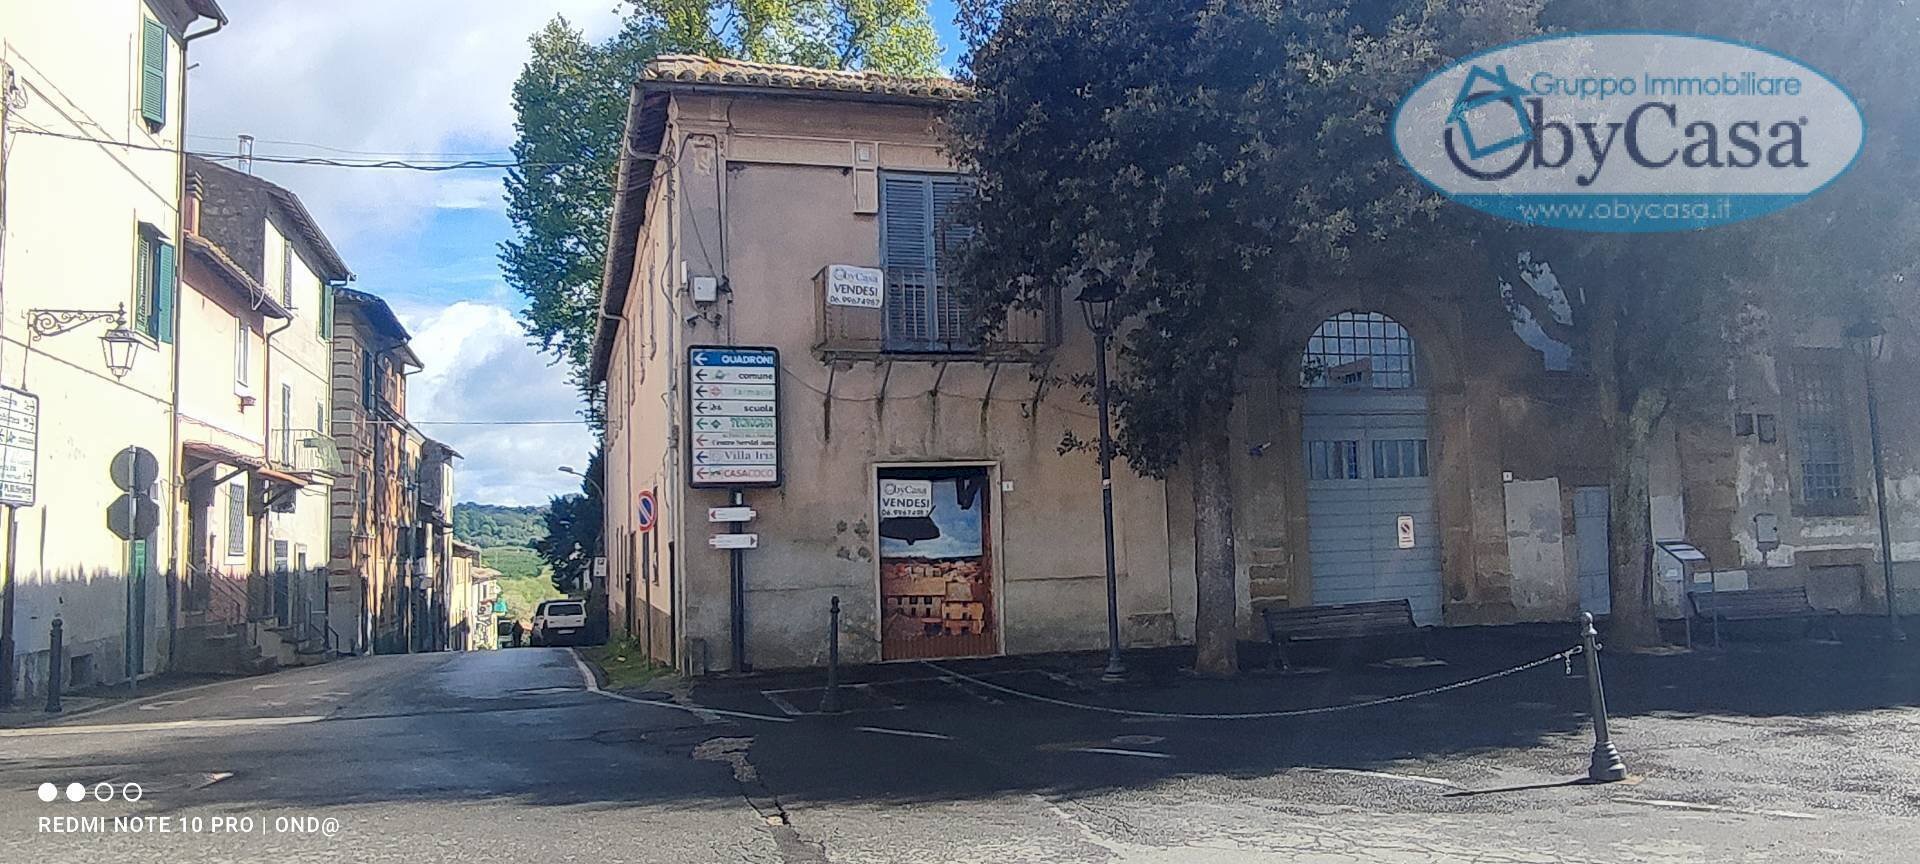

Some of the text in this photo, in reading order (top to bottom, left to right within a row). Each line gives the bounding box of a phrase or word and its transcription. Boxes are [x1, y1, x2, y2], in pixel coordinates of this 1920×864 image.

[833, 283, 878, 297] VENDESI
[721, 355, 774, 365] QUADRONI
[744, 404, 774, 412] scuola
[724, 451, 752, 460] Villa
[882, 498, 930, 508] VENDESI
